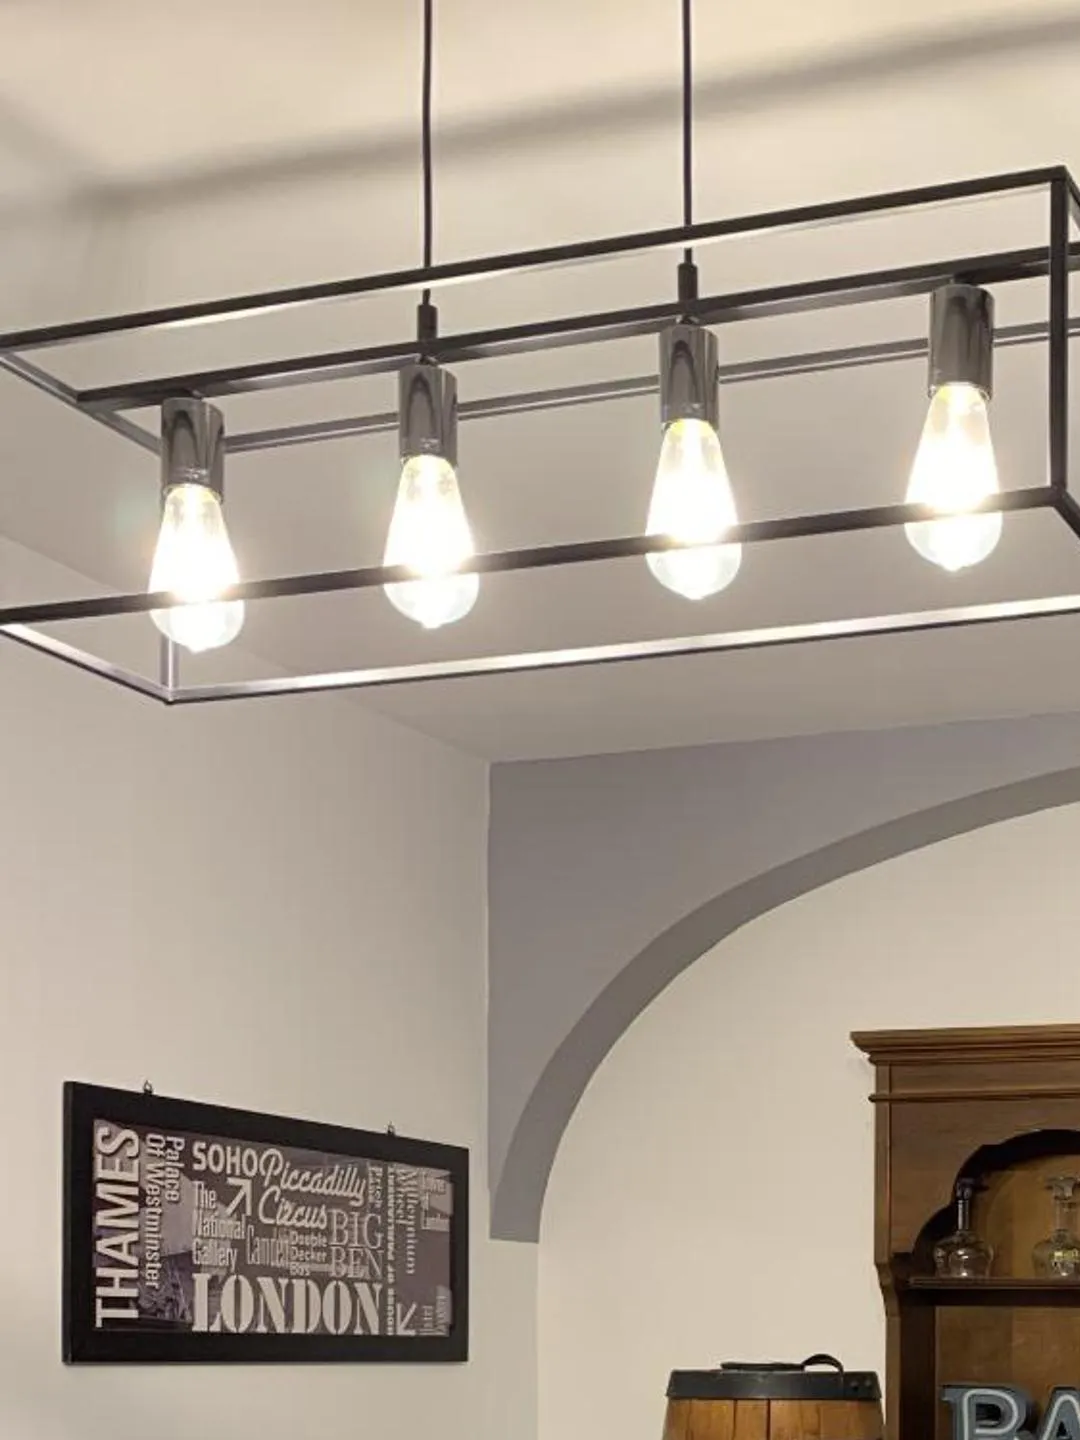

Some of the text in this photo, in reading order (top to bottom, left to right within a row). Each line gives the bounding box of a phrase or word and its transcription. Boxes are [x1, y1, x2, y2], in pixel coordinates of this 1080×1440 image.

[164, 1136, 185, 1203] Palace
[193, 1142, 258, 1178] SOHO
[259, 1148, 366, 1207] Piccadilly
[193, 1180, 217, 1210] The
[259, 1185, 328, 1230] Circus
[96, 1127, 139, 1328] THAMES
[145, 1162, 165, 1289] Westminster
[192, 1210, 246, 1240] National
[328, 1208, 384, 1249] BIG
[192, 1238, 238, 1272] Gallery
[328, 1245, 384, 1279] BEN
[191, 1272, 383, 1335] LONDON
